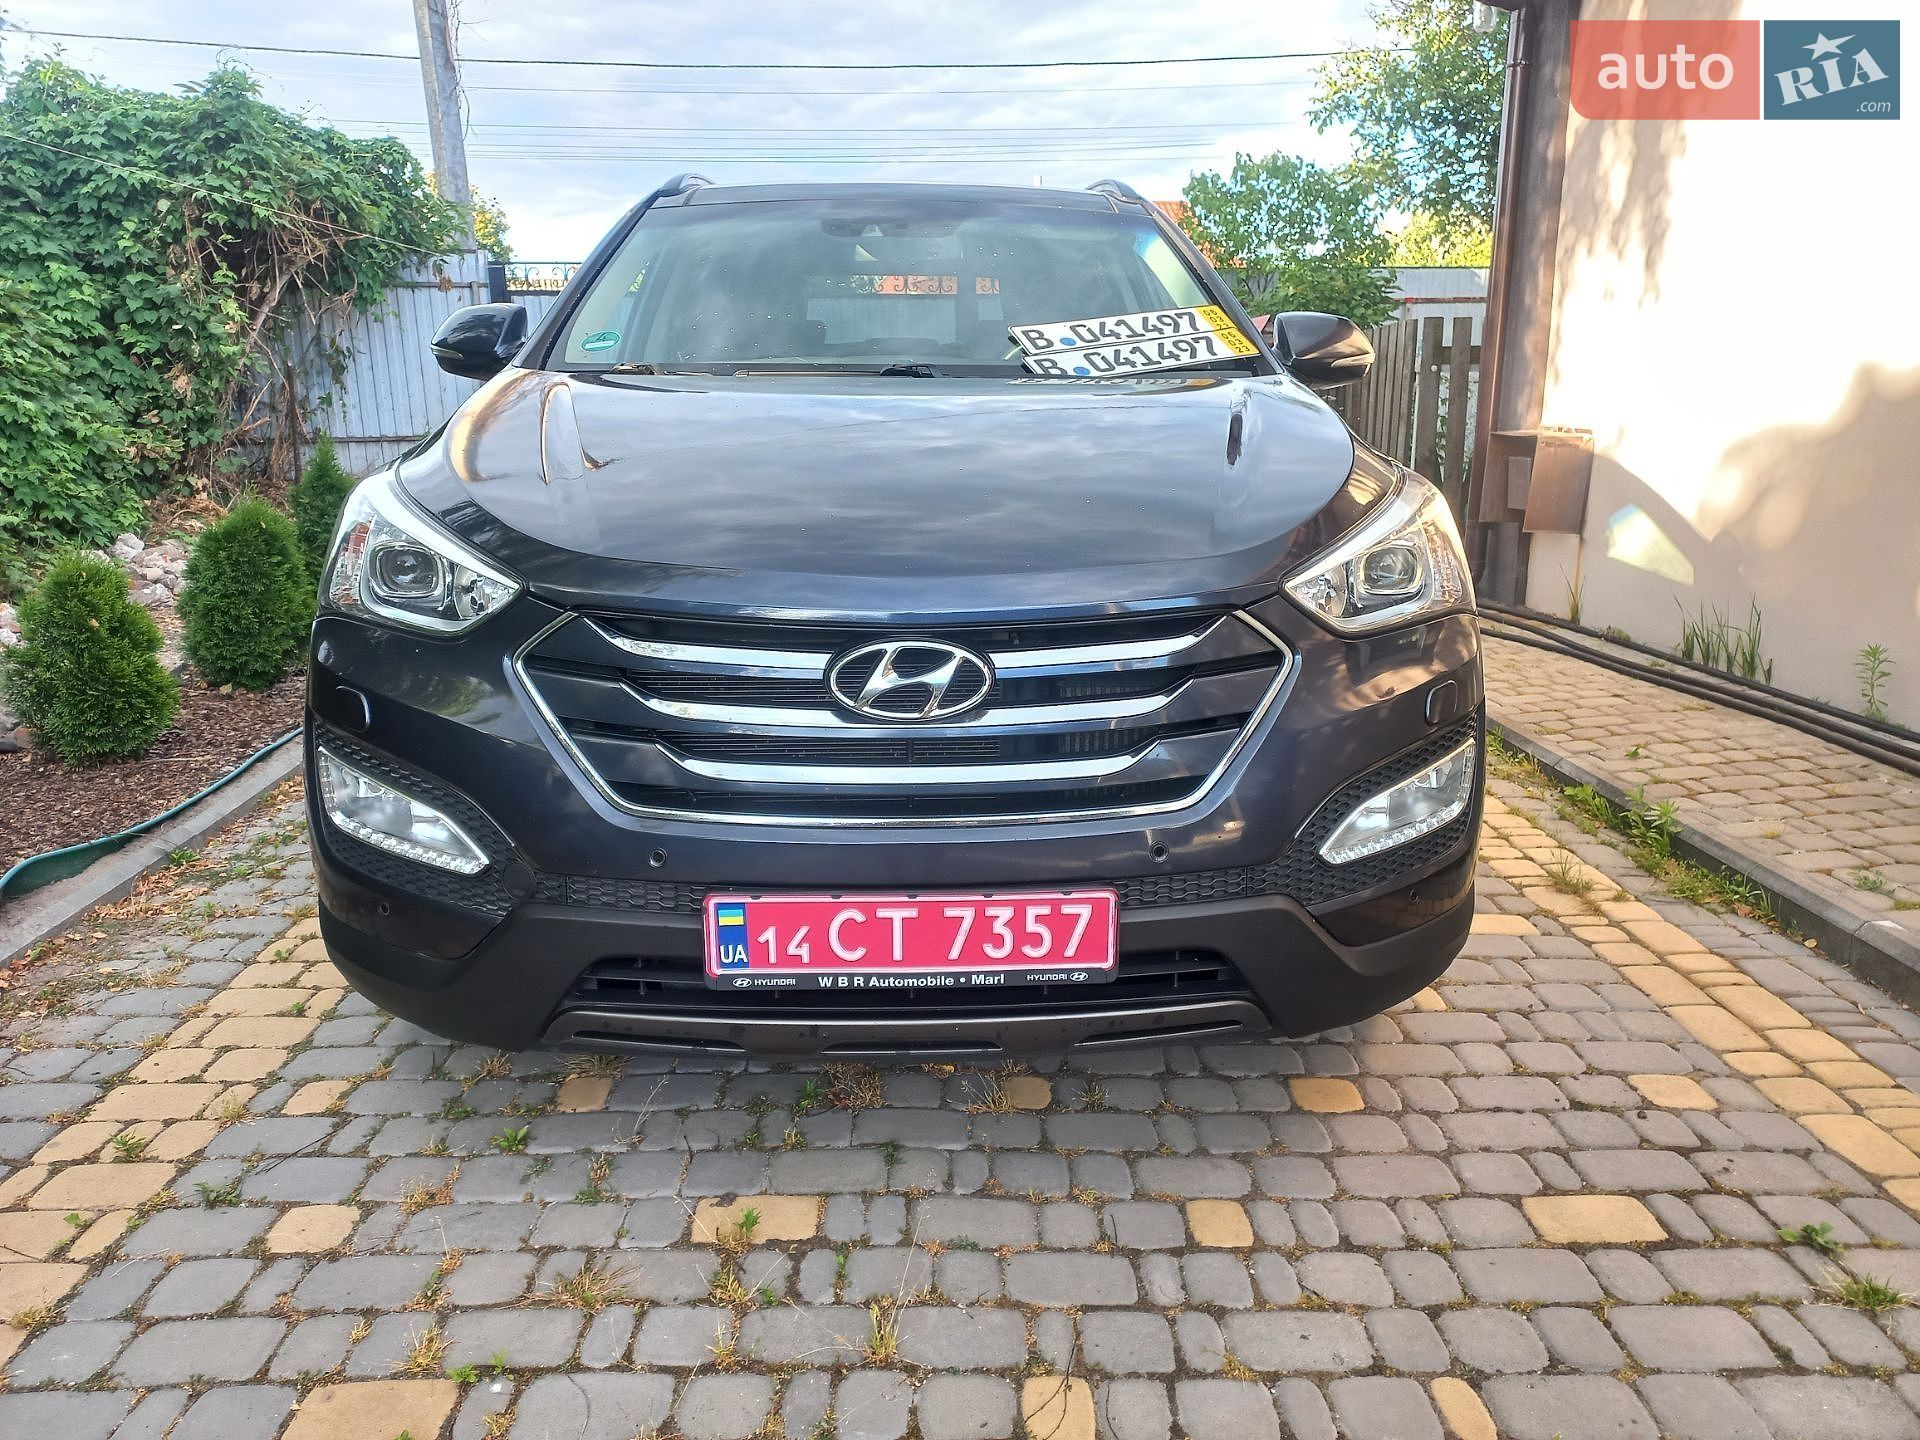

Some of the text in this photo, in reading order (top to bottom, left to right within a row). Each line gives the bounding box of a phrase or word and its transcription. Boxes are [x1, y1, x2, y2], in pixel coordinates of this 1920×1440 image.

[1021, 311, 1200, 350] B 041497
[1033, 335, 1218, 375] B 041497
[756, 904, 1093, 964] 14 CT 7357
[719, 944, 748, 964] UA
[754, 978, 796, 986] HYUNDAI
[868, 975, 954, 987] Automobile
[971, 974, 1005, 985] Marl
[1027, 973, 1067, 981] HYUNDAI
